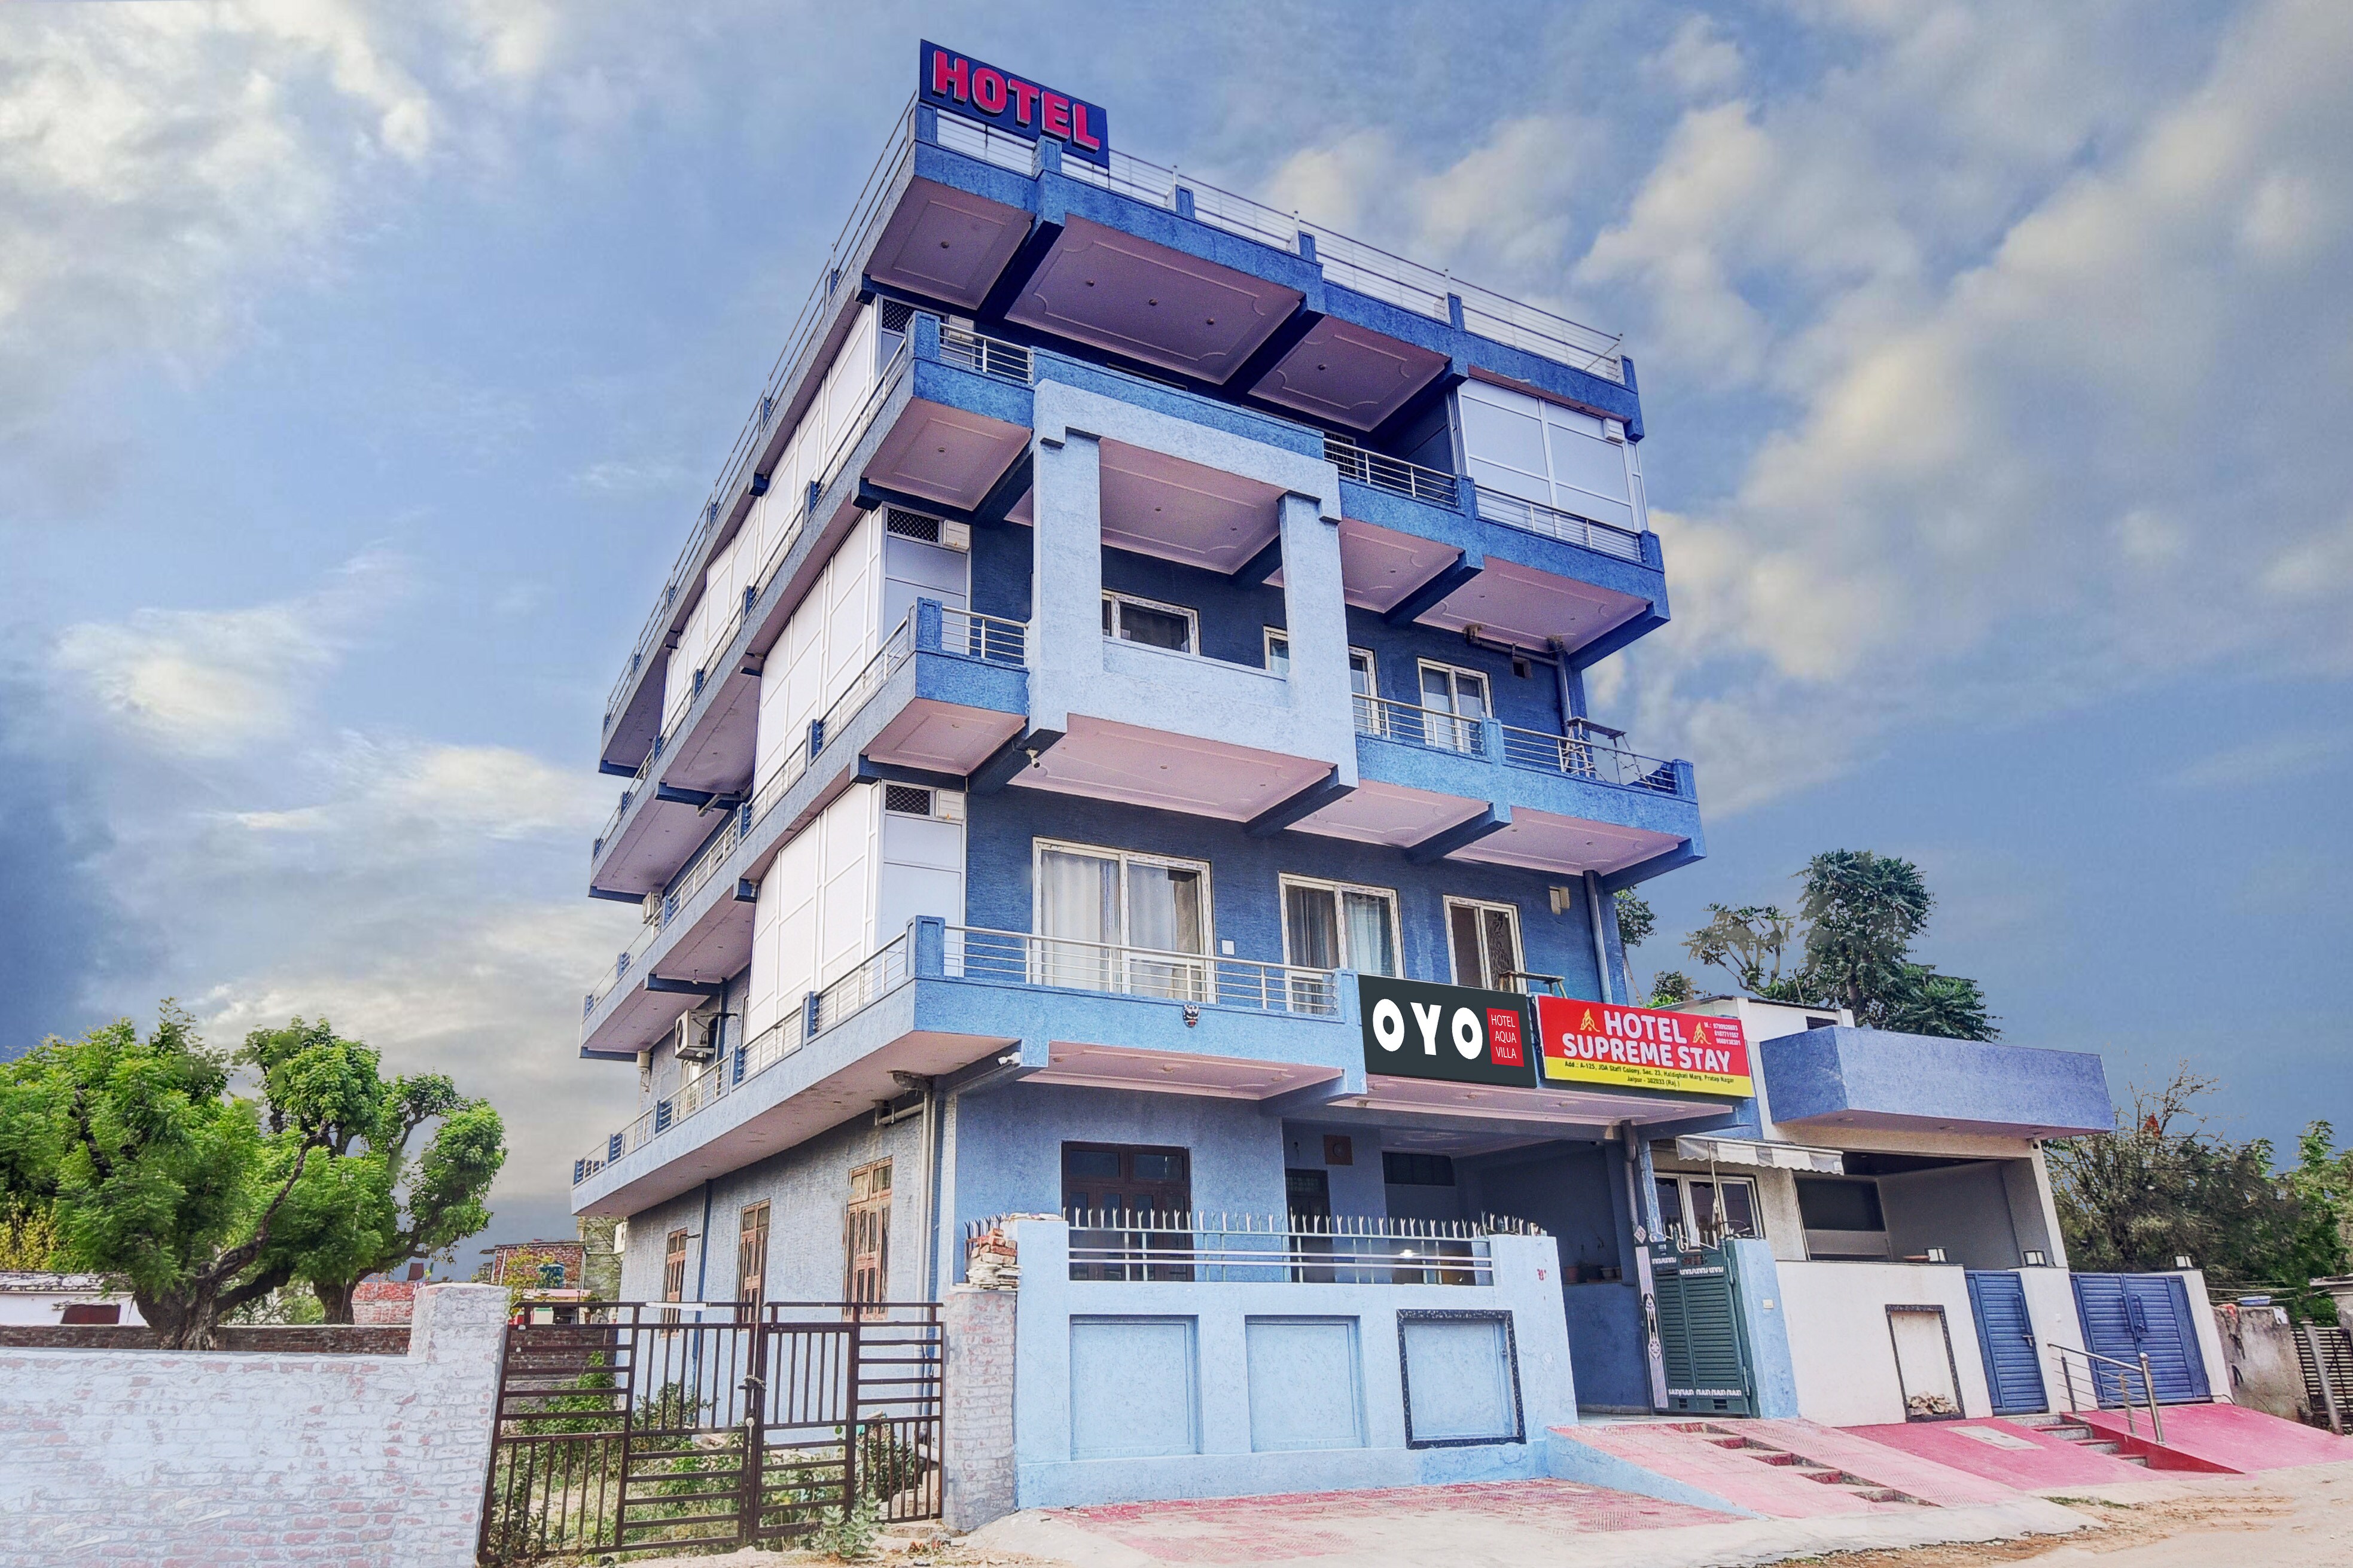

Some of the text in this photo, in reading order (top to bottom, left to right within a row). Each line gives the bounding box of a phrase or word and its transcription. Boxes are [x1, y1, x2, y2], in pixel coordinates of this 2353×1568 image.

[932, 50, 1101, 150] HOTEL
[1373, 999, 1483, 1060] OYO
[1491, 1014, 1516, 1027] HOTEL
[1495, 1031, 1517, 1044] AQUA
[1604, 1010, 1687, 1044] HOTEL
[1495, 1046, 1517, 1059] VILLA
[1562, 1033, 1730, 1072] SUPREME STAY
